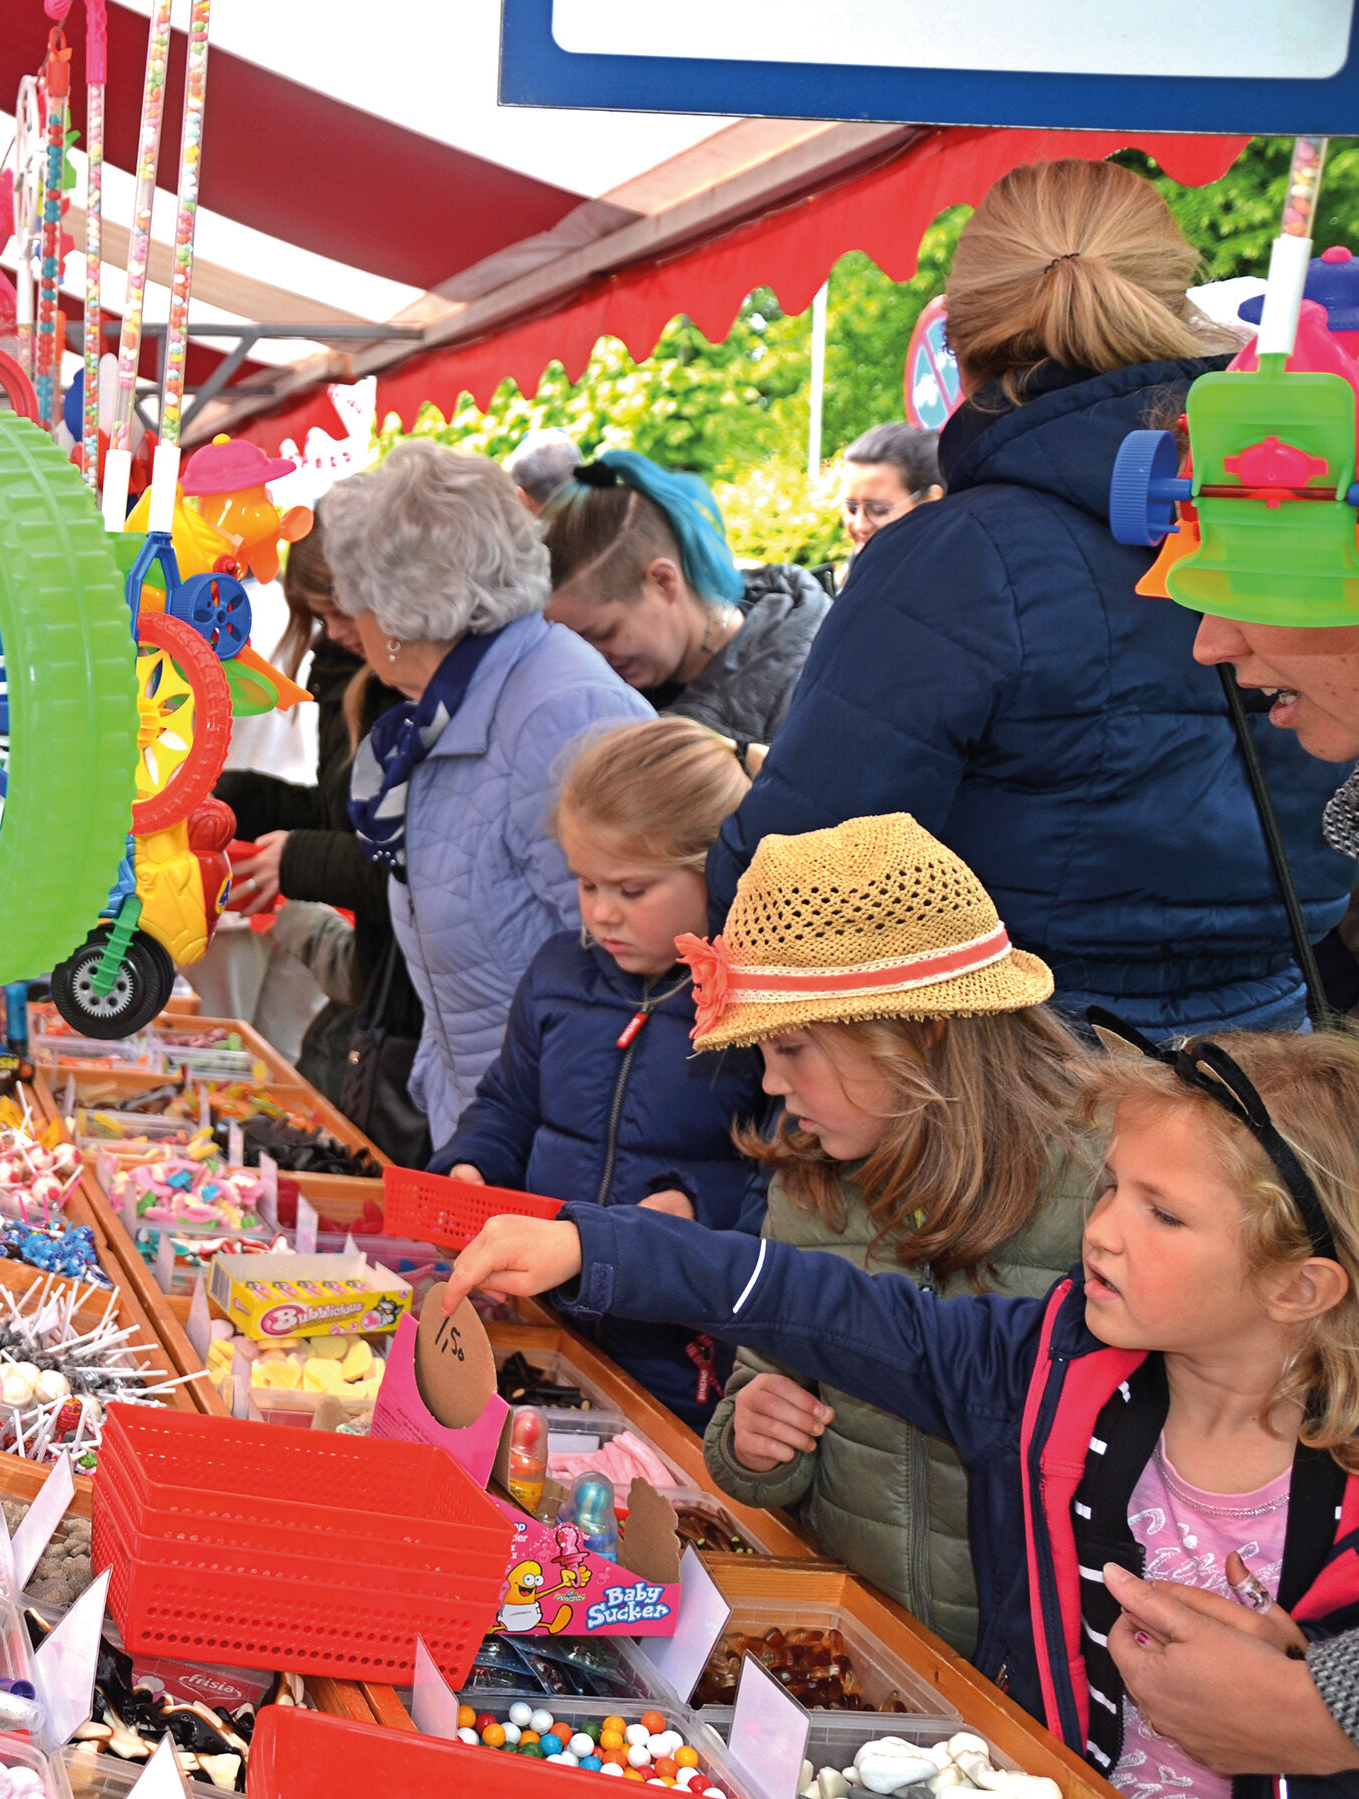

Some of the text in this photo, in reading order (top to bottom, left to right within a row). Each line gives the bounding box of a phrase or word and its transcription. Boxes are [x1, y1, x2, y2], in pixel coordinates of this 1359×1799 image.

[271, 1302, 364, 1331] Bubblicious
[435, 1316, 466, 1362] 1,50
[605, 1582, 664, 1606] Baby
[587, 1603, 670, 1630] Sucker
